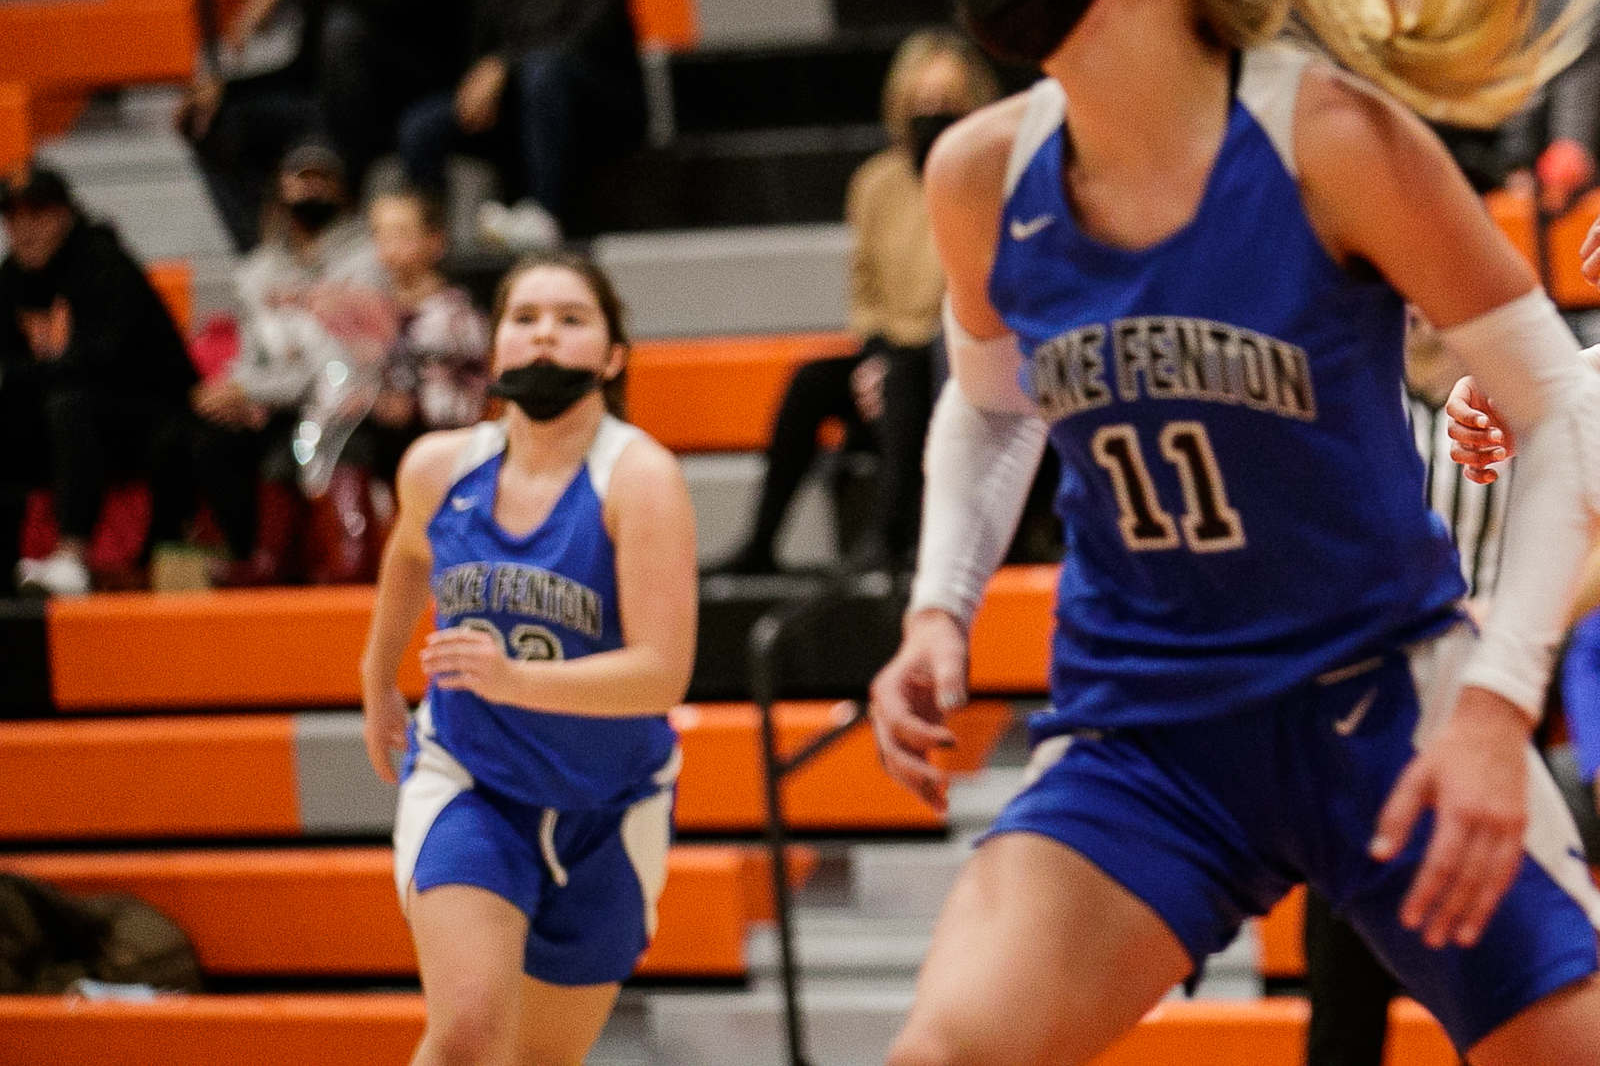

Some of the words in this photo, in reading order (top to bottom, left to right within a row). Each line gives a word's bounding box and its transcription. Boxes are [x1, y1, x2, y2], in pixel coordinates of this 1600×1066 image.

[1033, 323, 1113, 423] AKE
[1111, 315, 1317, 422] FENTON
[1091, 420, 1247, 553] 11
[435, 561, 487, 618] AKE
[491, 562, 602, 640] FENTON
